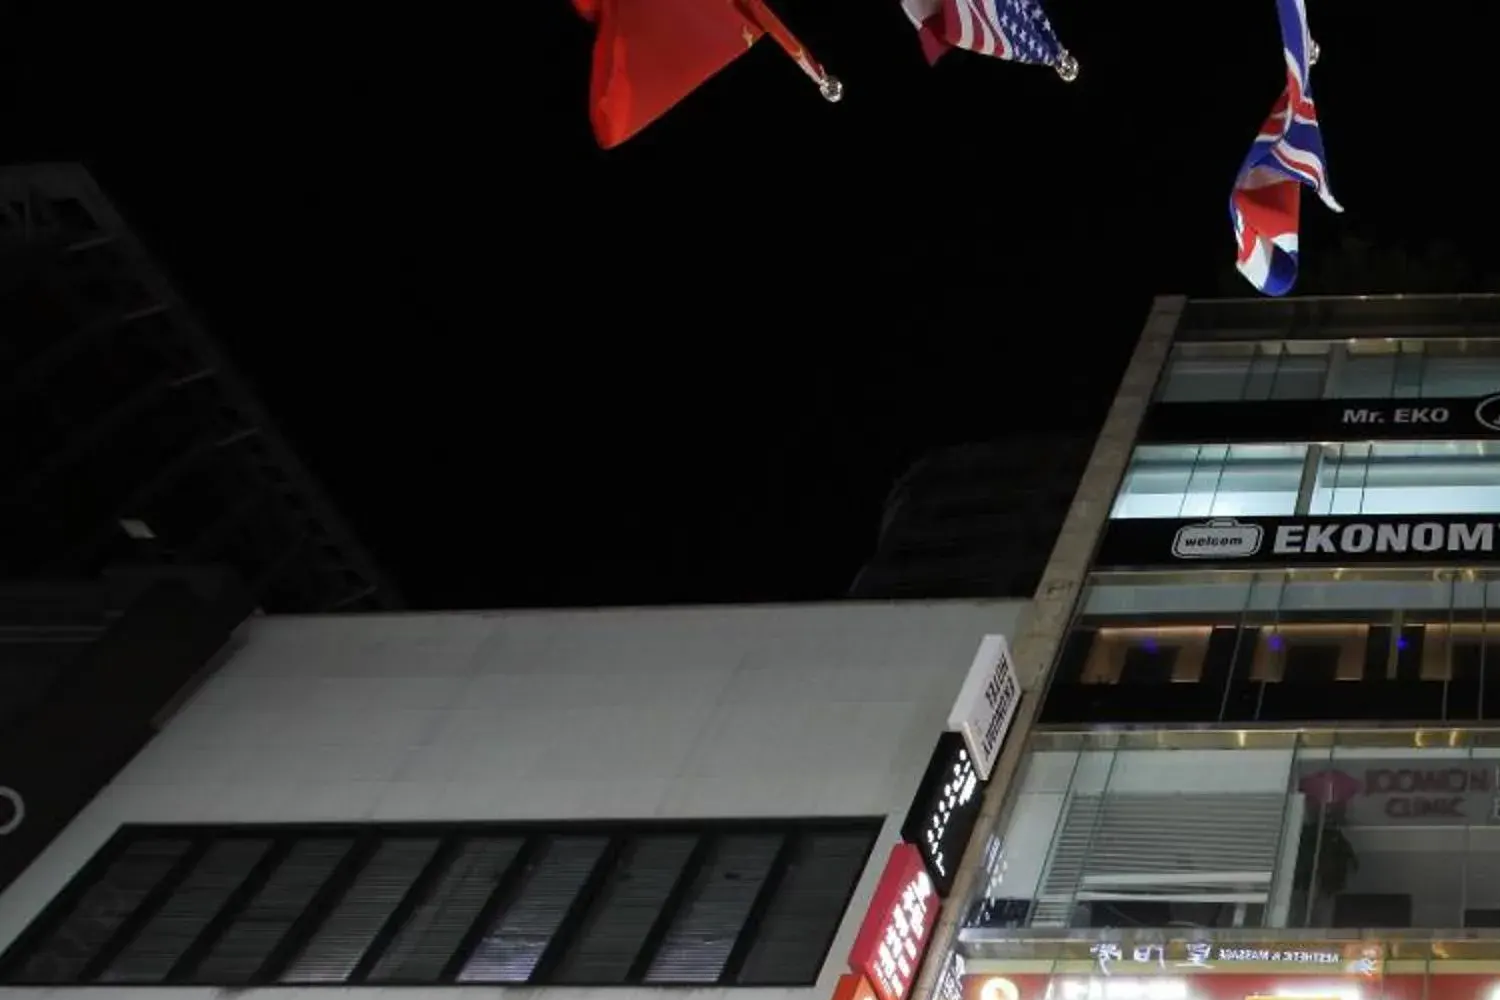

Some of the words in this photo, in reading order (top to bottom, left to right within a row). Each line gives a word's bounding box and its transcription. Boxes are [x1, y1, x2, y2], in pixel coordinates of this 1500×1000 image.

[1342, 407, 1384, 424] Mr.
[1393, 407, 1450, 424] EKO
[1184, 535, 1244, 548] welcom
